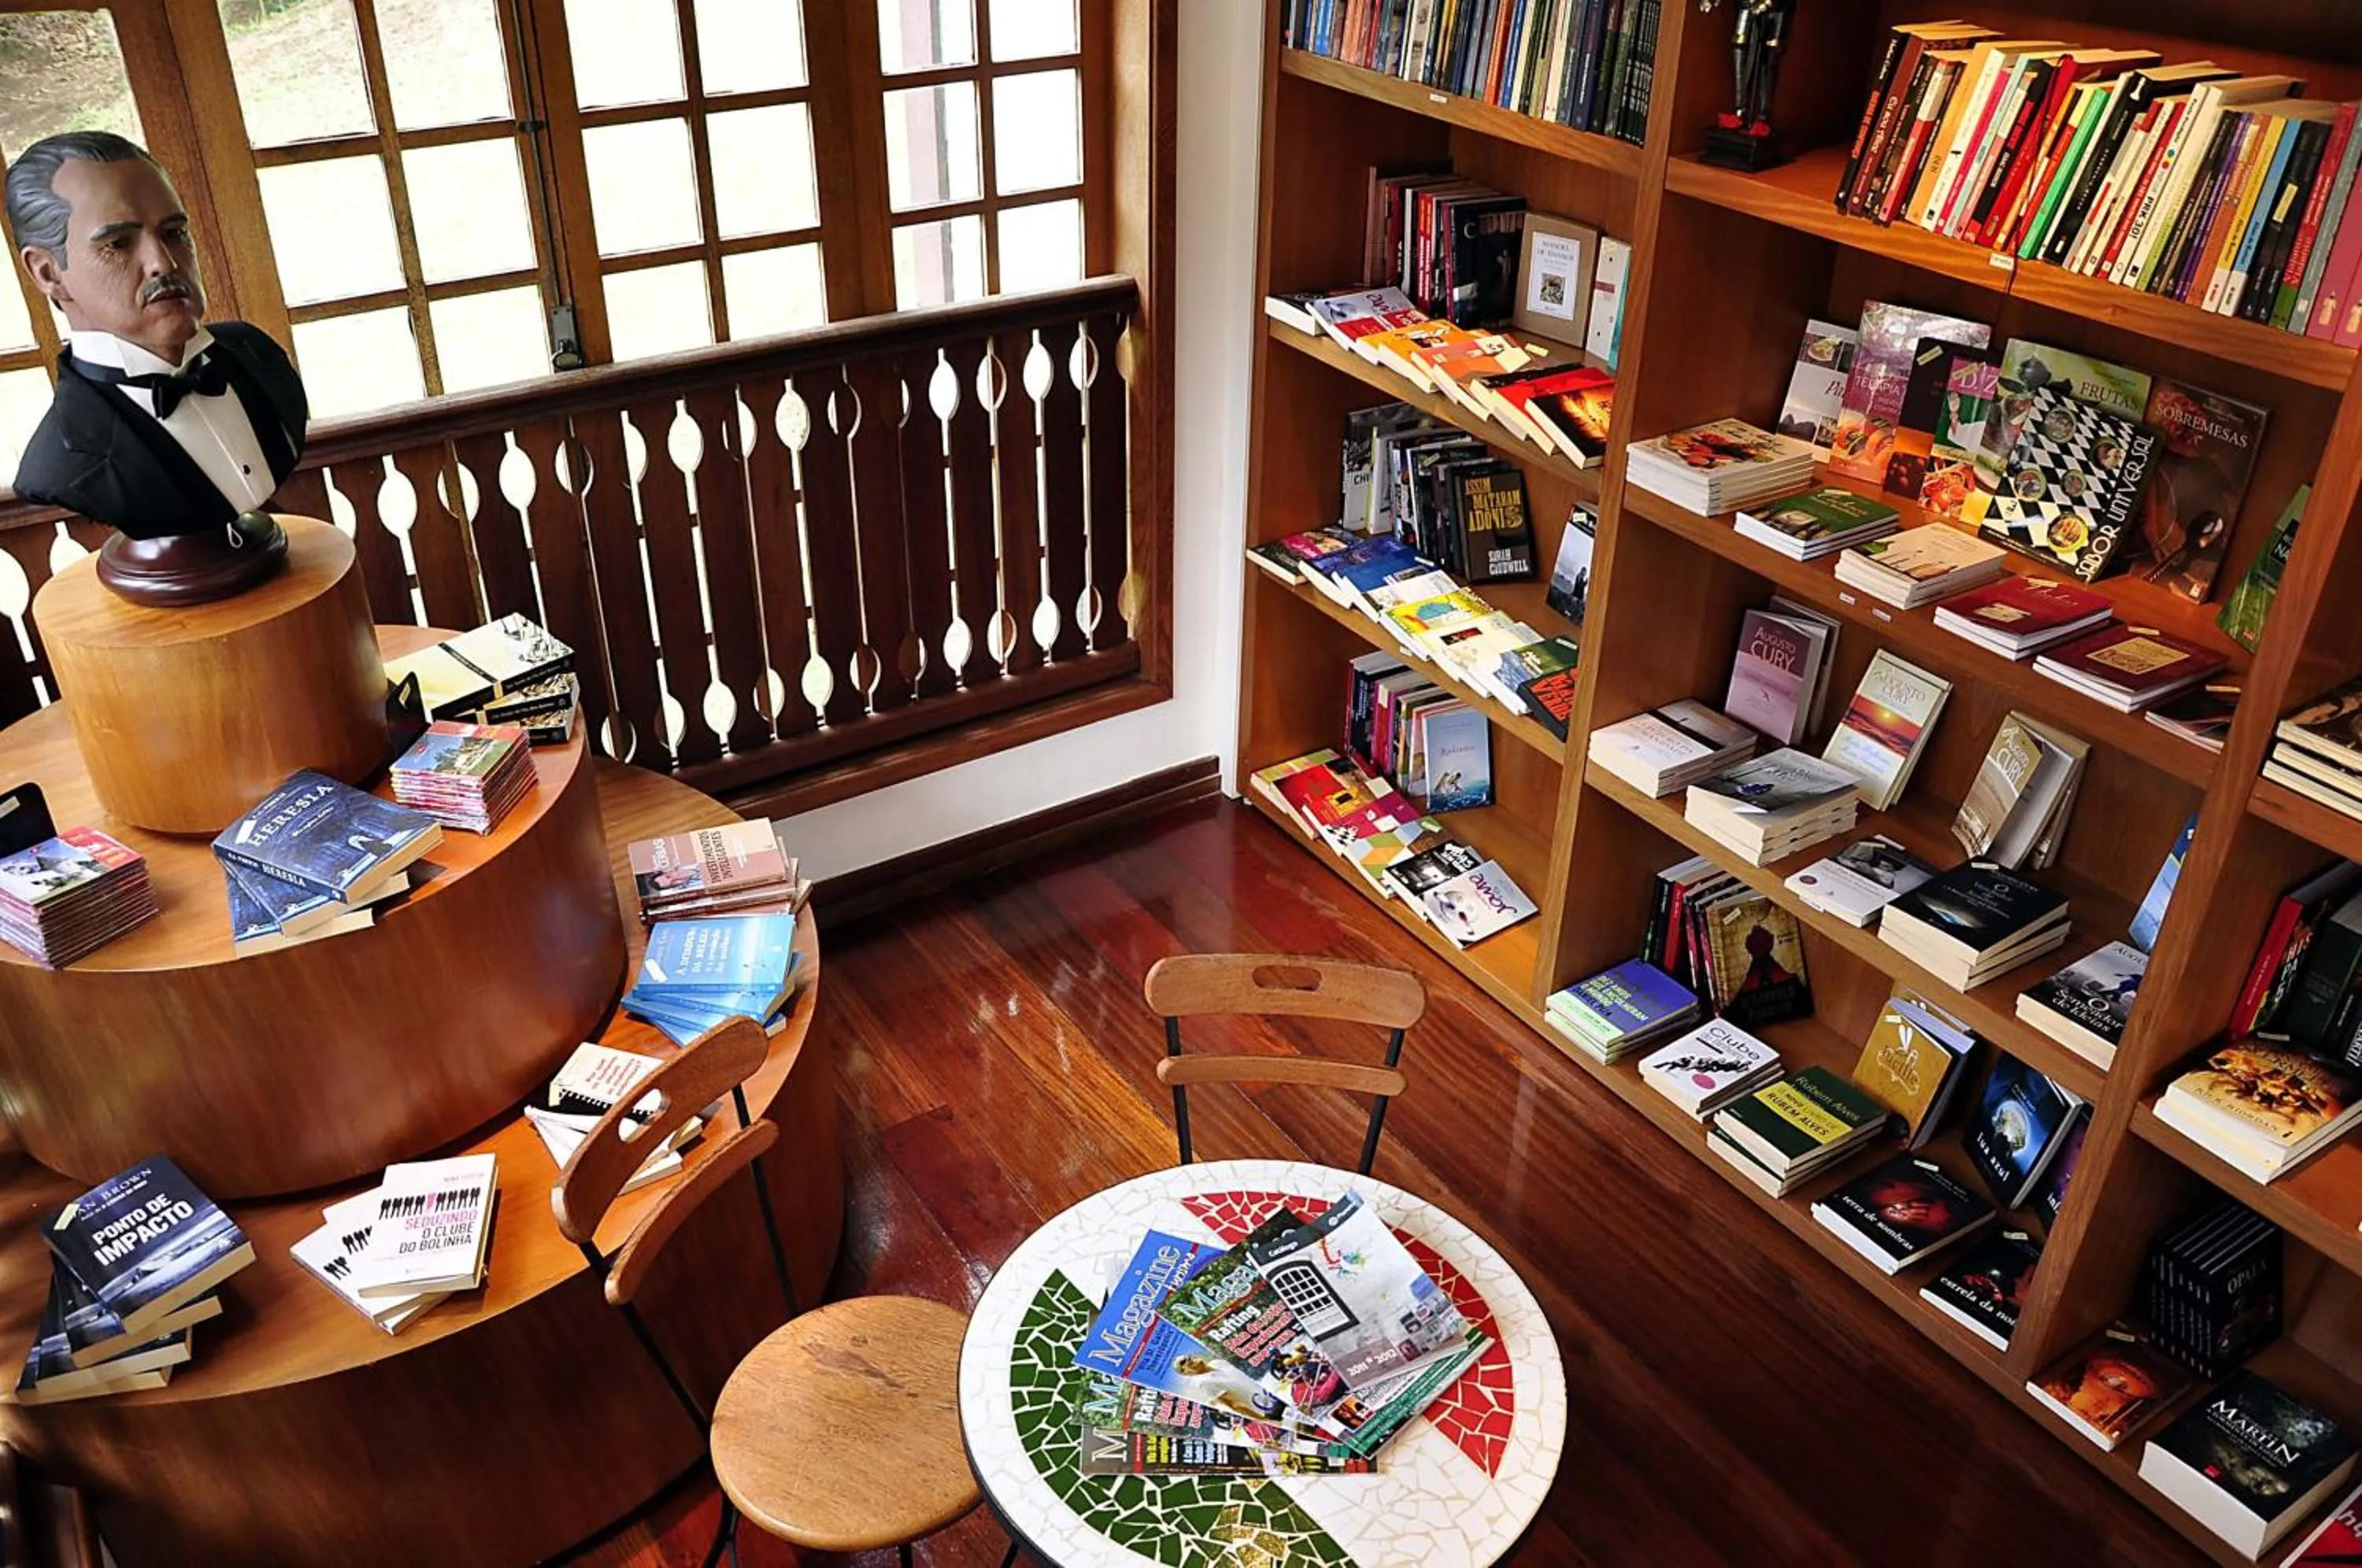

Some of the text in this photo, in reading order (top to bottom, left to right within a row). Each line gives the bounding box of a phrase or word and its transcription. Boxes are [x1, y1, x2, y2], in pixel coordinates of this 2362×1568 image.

[2139, 196, 2156, 220] PRK
[2080, 382, 2138, 410] FRUTAS
[2156, 402, 2249, 449] SOBREMESAS
[2075, 435, 2155, 582] SABOR UNIVERSAL
[1750, 640, 1796, 672] CURY
[1755, 626, 1797, 653] AUGUSTO
[1996, 748, 2026, 784] CURY
[248, 783, 335, 847] HERESIA
[262, 864, 306, 887] HERESIA
[2055, 988, 2124, 1028] Semeador
[1709, 1026, 1761, 1061] Clube
[1766, 1091, 1831, 1138] RUBEM ALVES
[100, 1167, 153, 1200] BROWN
[1990, 1157, 2010, 1182] azul
[91, 1193, 172, 1245] PONTO DE
[93, 1200, 194, 1267] IMPACTO
[405, 1210, 479, 1230] SEDUZINDO
[421, 1221, 475, 1239] O CLUBE
[1842, 1195, 1914, 1252] terra de sombras
[399, 1233, 472, 1254] DO BOLINHA
[1087, 1244, 1181, 1367] Magazine
[1170, 1264, 1261, 1326] Maga
[1939, 1275, 1979, 1303] estrela
[1979, 1299, 1995, 1313] da
[1208, 1304, 1261, 1343] Rafting
[1345, 1348, 1398, 1377] 2011 2012
[1134, 1388, 1159, 1423] Rafti
[2211, 1399, 2301, 1463] MARTIN
